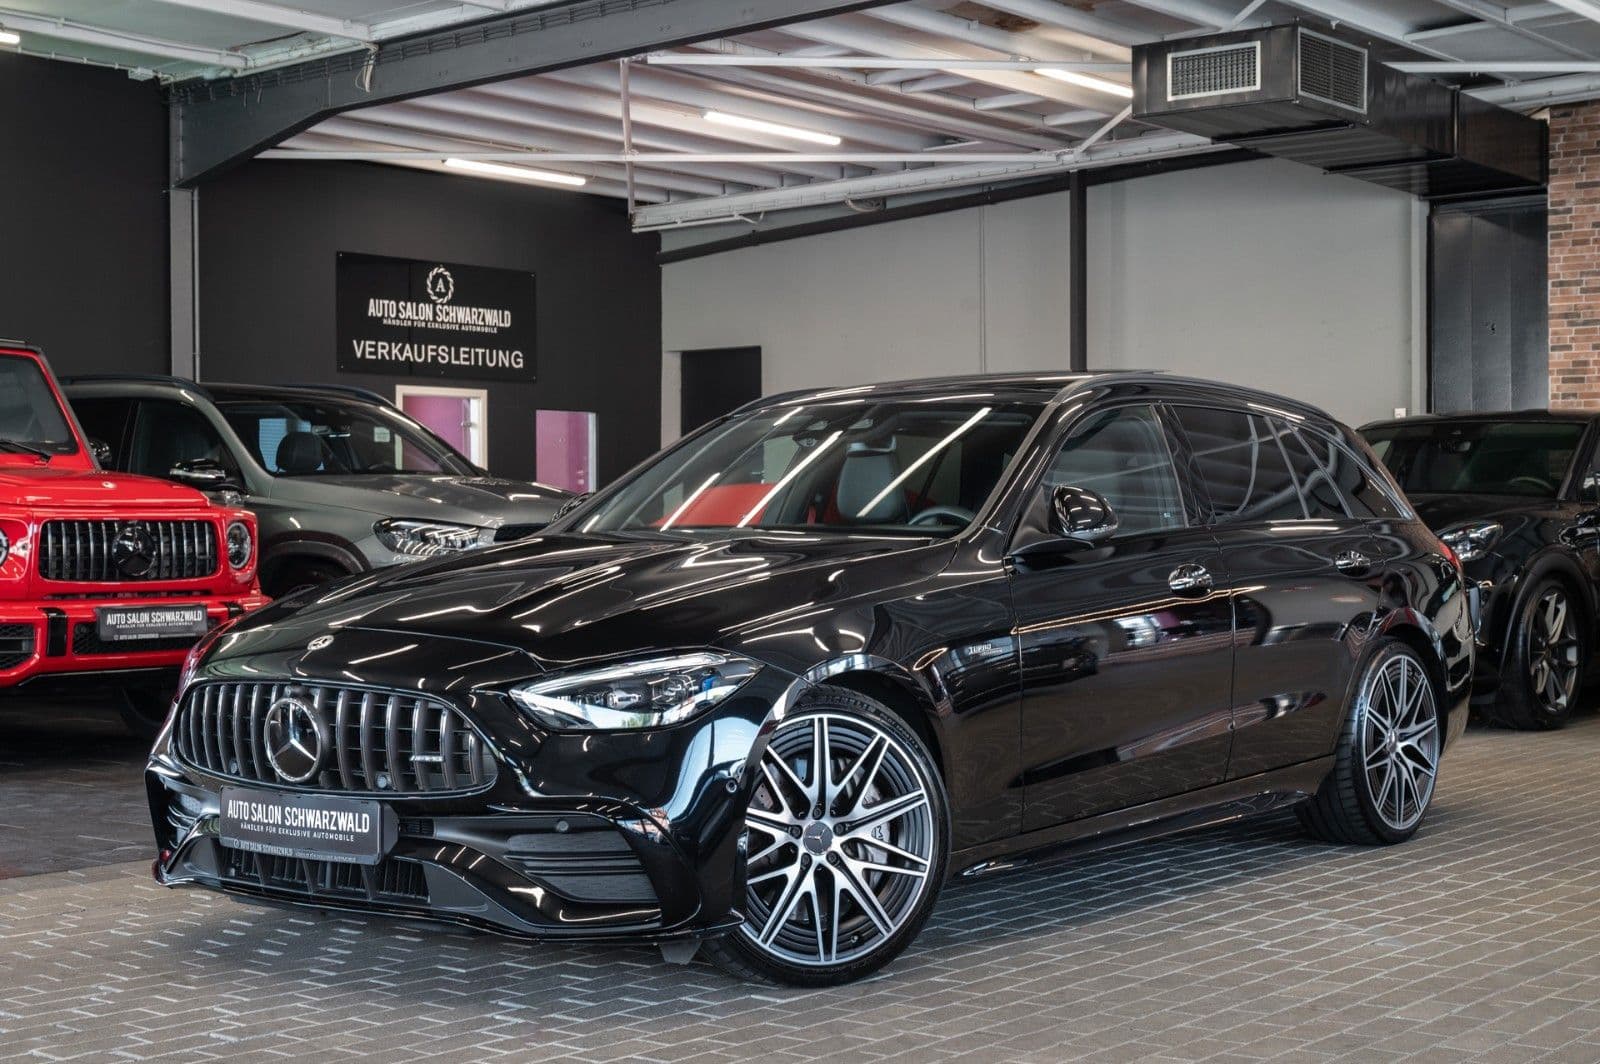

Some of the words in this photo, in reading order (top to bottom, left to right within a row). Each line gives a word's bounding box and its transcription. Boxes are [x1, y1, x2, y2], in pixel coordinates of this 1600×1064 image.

[367, 298, 397, 318] AUTO
[398, 301, 433, 321] SALON
[435, 304, 511, 328] SCHWARZWALD
[352, 339, 524, 369] VERKAUFSLEITUNG
[106, 613, 126, 626] AUTO
[126, 611, 150, 624] SALON
[151, 609, 203, 624] SCHWARZWALD
[227, 799, 249, 821] AUTO
[250, 802, 282, 825] SALON
[284, 806, 370, 833] SCHWARZWALD
[240, 822, 264, 833] HÄNDLER
[278, 827, 310, 838] EXKLUSIVE
[312, 831, 354, 842] AUTOMOBILE
